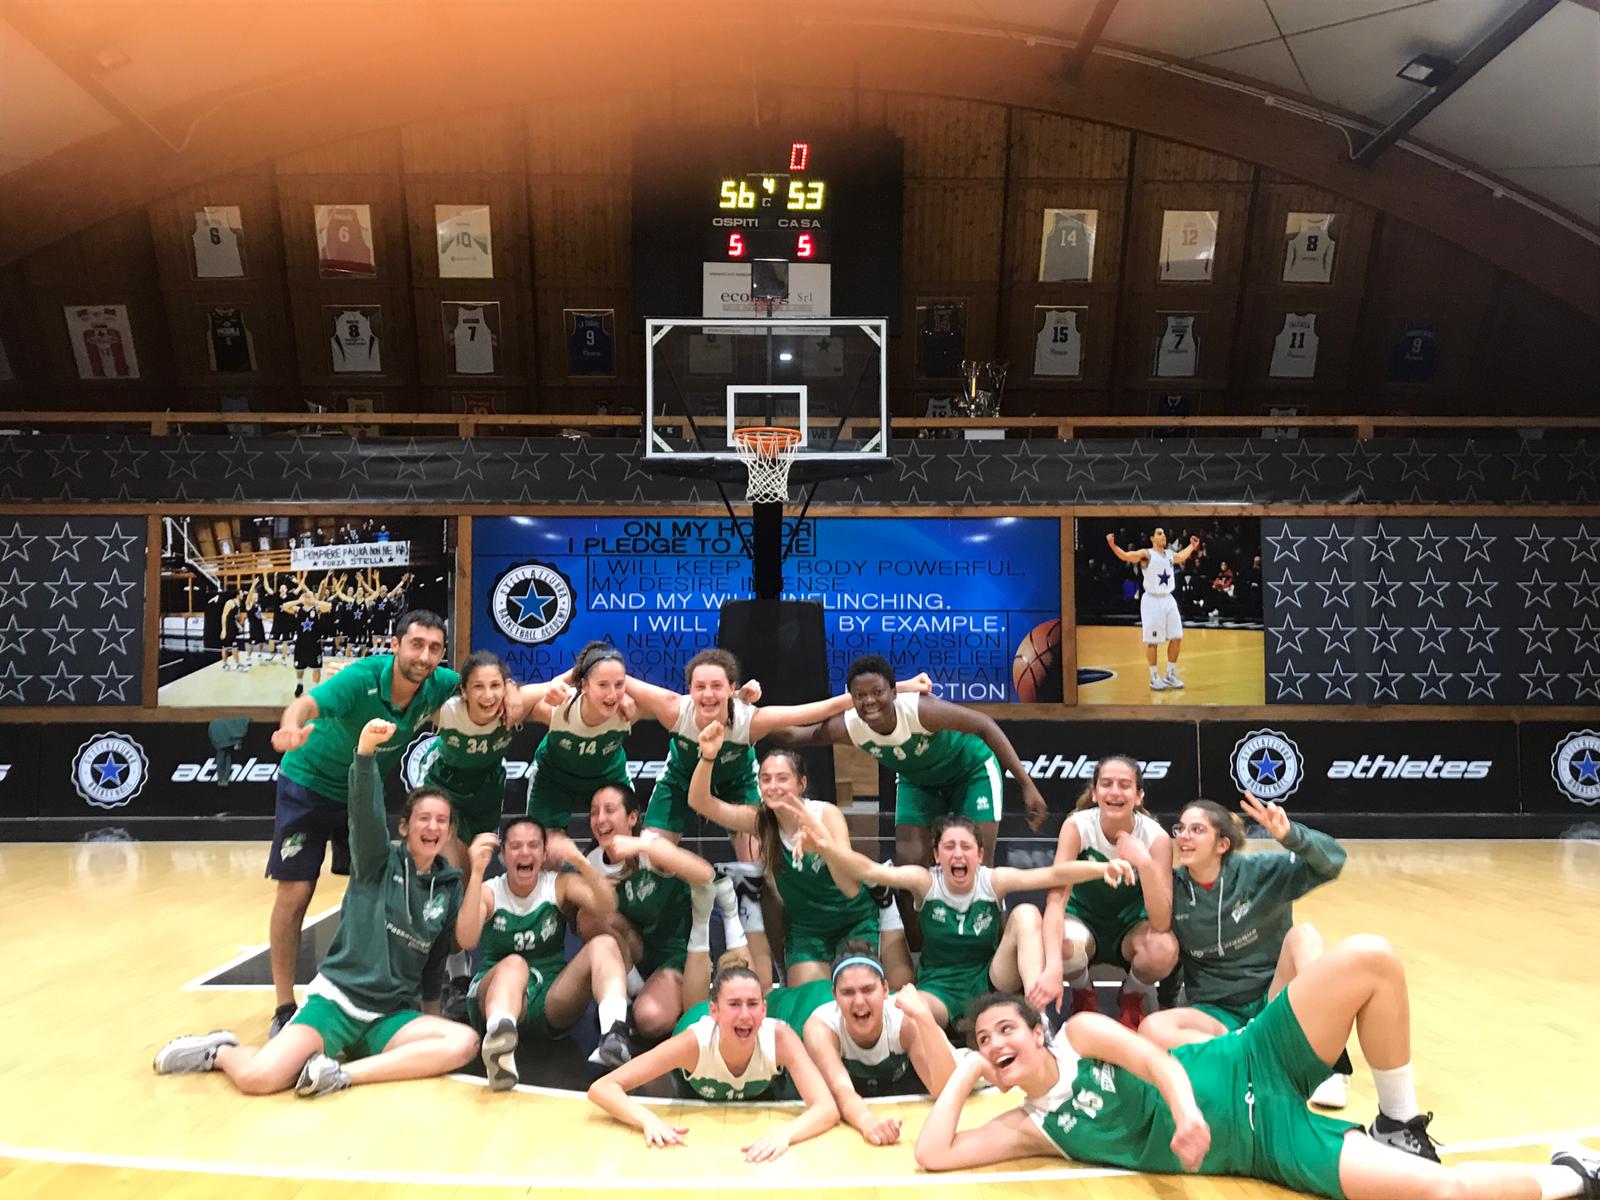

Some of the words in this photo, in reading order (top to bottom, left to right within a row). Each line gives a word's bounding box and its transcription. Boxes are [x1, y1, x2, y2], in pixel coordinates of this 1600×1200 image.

[790, 143, 807, 170] 0
[719, 181, 755, 209] 56
[762, 178, 774, 193] 4
[787, 182, 824, 210] 53
[712, 218, 758, 228] OSPITI
[778, 218, 821, 228] CASA
[209, 227, 221, 245] 6
[338, 226, 350, 242] 6
[1060, 229, 1077, 246] 14
[1182, 229, 1198, 246] 12
[728, 234, 742, 256] 5
[797, 235, 811, 257] 5
[1307, 235, 1318, 251] 8
[467, 326, 477, 342] 7
[586, 330, 595, 345] 9
[1052, 326, 1068, 343] 15
[1174, 334, 1185, 349] 7
[1289, 332, 1305, 349] 11
[1413, 337, 1422, 352] 9
[624, 521, 661, 537] ON
[672, 522, 708, 537] MY
[585, 538, 687, 553] PLEDGE
[695, 538, 731, 553] TO
[350, 557, 384, 566] STELLA
[608, 561, 664, 575] WILL
[677, 561, 740, 575] KEEP
[797, 560, 867, 575] BODY
[879, 560, 1026, 577] POWERFUL.
[592, 577, 628, 591] MY
[640, 577, 730, 591] DESIRE
[592, 593, 646, 609] AND
[657, 593, 692, 609] MY
[649, 616, 707, 632] WILL
[839, 616, 871, 632] BY
[882, 616, 1007, 633] EXAMPLE,
[602, 633, 616, 648] A
[626, 633, 684, 648] NEW
[846, 633, 880, 648] OF
[891, 633, 1000, 648] PASSION
[505, 650, 551, 665] AND
[889, 650, 920, 664] MY
[929, 650, 1001, 664] BELIEF
[467, 739, 488, 754] 34
[578, 741, 596, 755] 14
[1327, 754, 1492, 779] athletes
[956, 914, 966, 936] 7
[514, 930, 536, 950] 32
